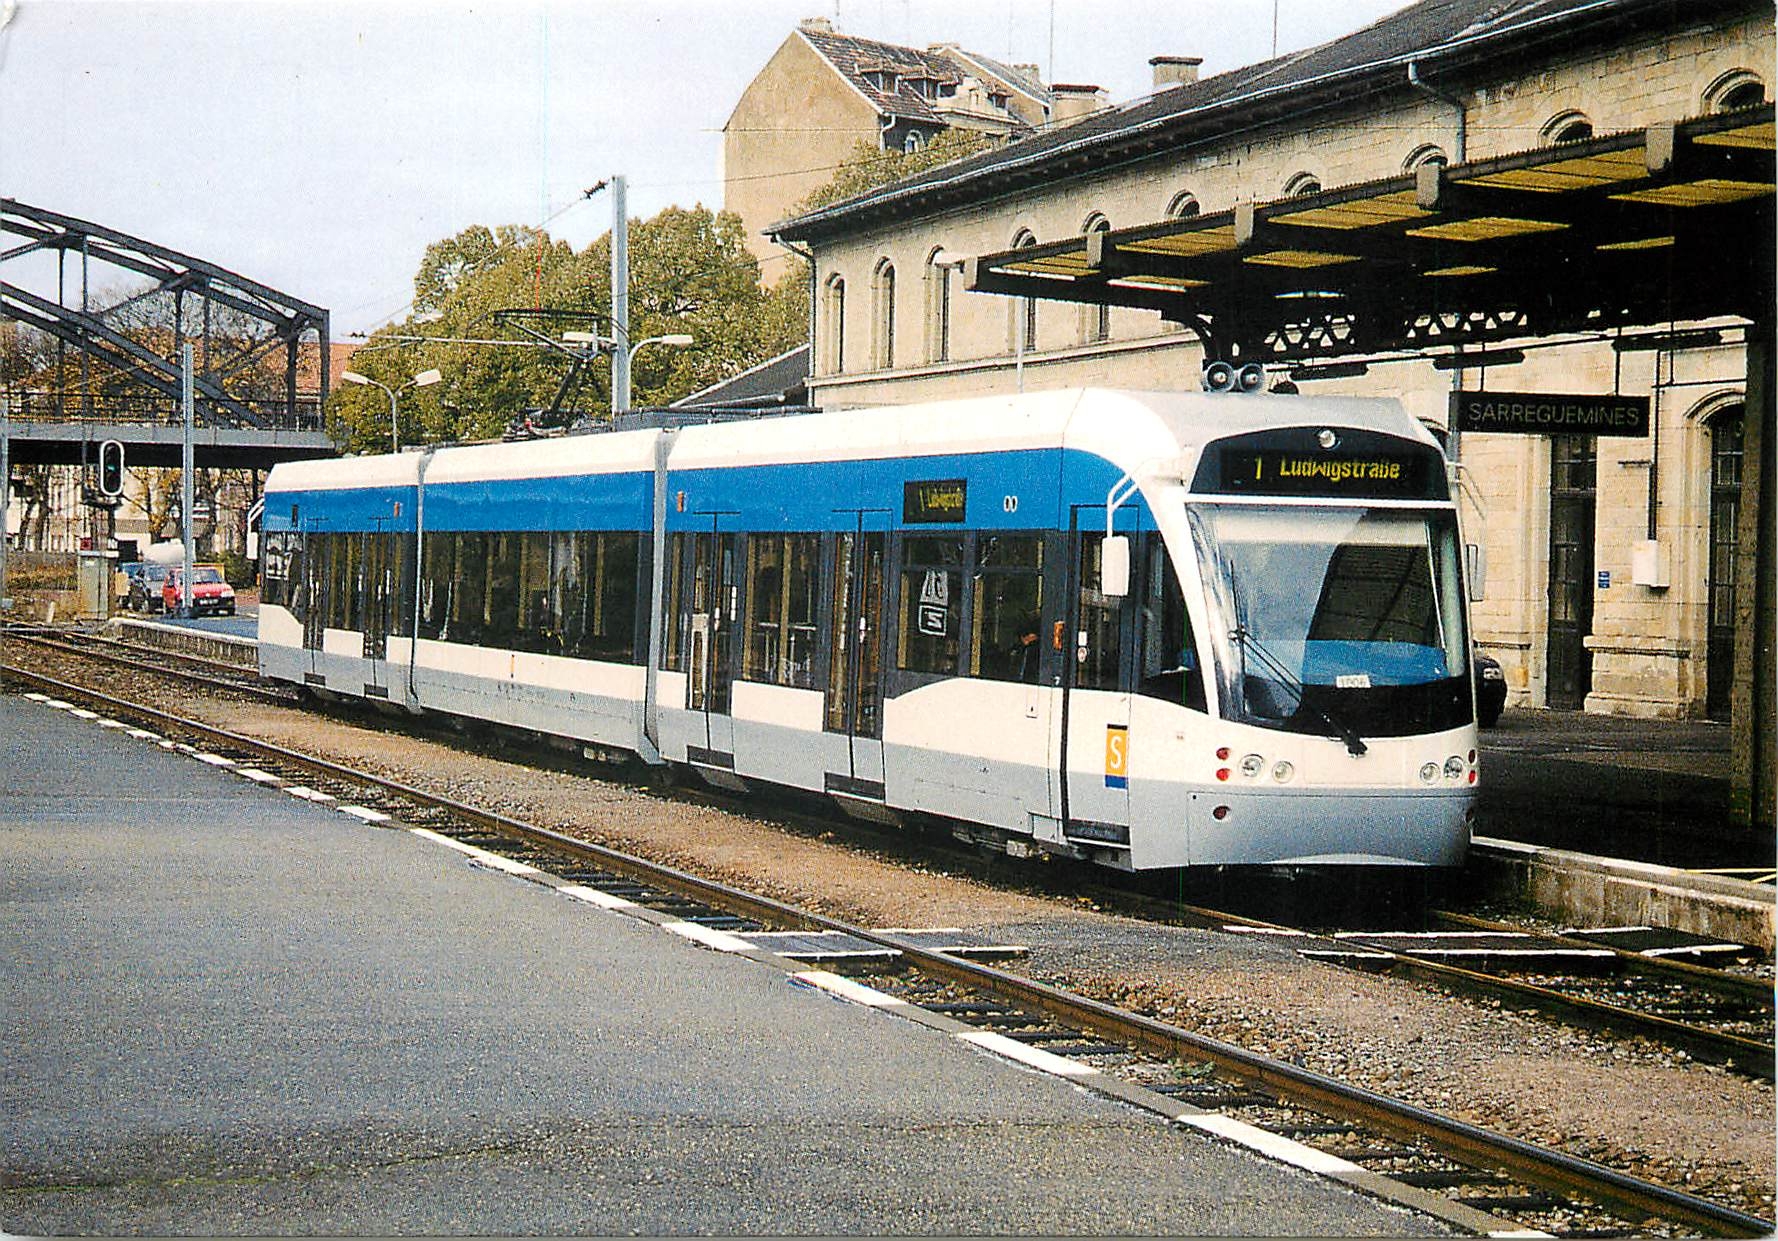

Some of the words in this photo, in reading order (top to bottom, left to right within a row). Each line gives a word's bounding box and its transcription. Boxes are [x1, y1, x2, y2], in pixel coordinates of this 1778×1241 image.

[1468, 402, 1640, 427] SARREGUEMINES
[1255, 455, 1263, 480] 1
[1279, 455, 1401, 482] Ludwigstraße
[1110, 735, 1123, 769] S
